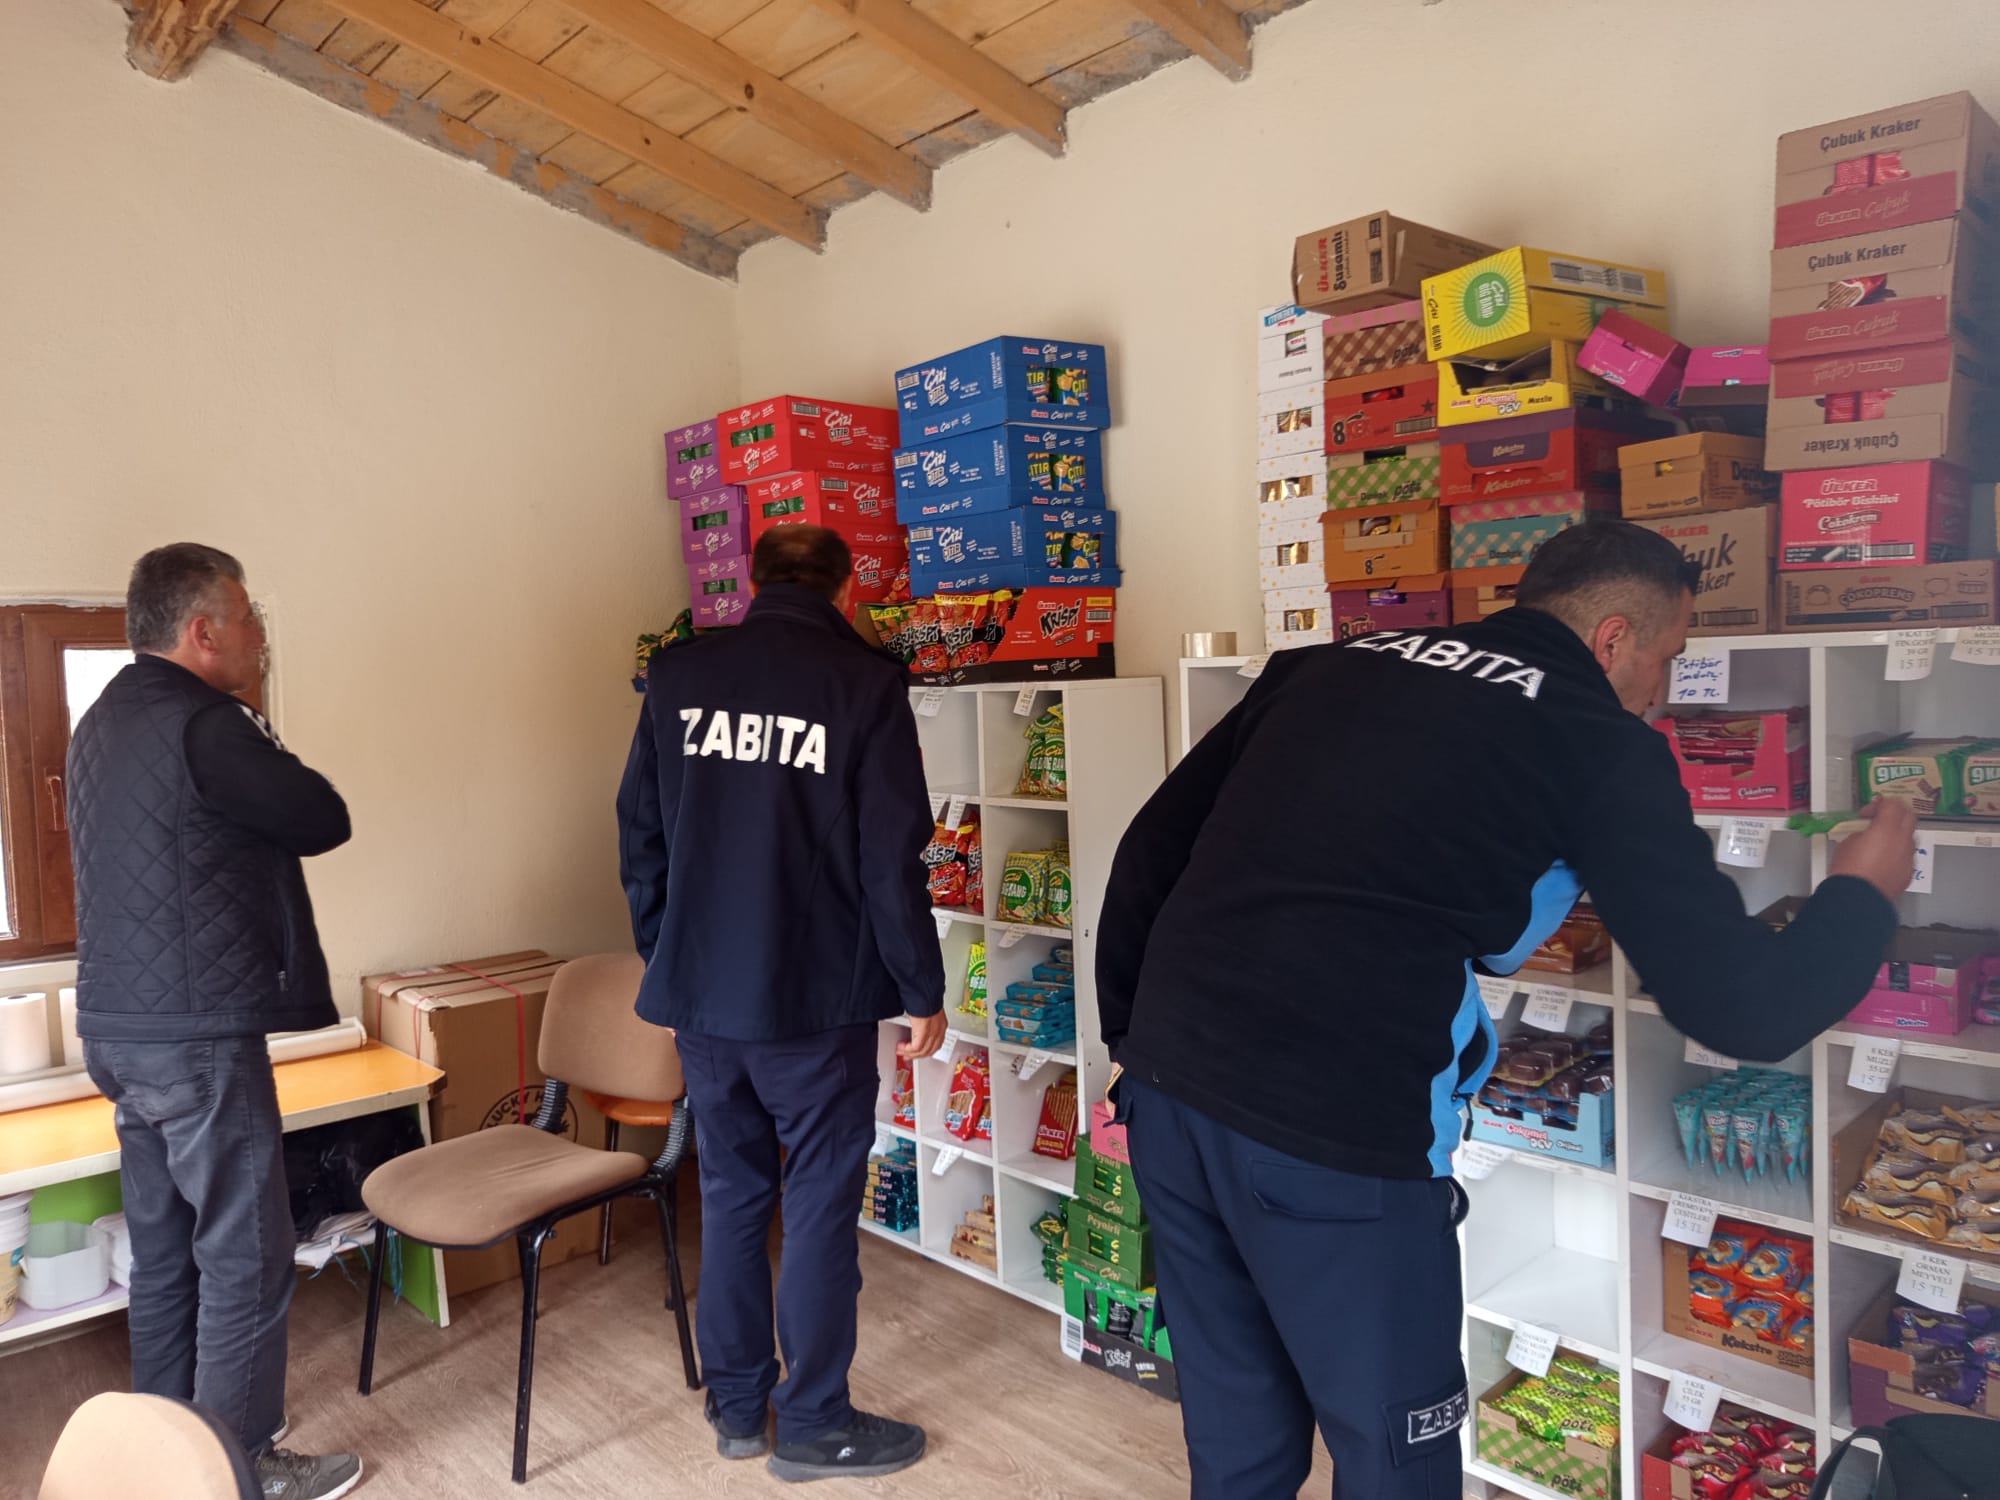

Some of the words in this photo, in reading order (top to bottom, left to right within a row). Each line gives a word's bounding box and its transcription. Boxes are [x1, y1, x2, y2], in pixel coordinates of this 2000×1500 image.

[1820, 129, 1866, 153] Çubuk
[1870, 118, 1921, 140] Kraker
[1808, 251, 1852, 272] Çubuk
[1857, 243, 1907, 262] Kraker
[923, 366, 948, 392] Çizi
[824, 410, 853, 428] Çizi
[1332, 420, 1346, 446] 8
[1854, 431, 1899, 450] Çubuk
[1803, 440, 1851, 453] Kraker
[922, 450, 947, 471] Çizi
[853, 483, 881, 501] Çizi
[1820, 477, 1878, 495] ÜLKER
[1803, 497, 1850, 509] Pötibör
[1817, 510, 1880, 534] Çokokrem
[938, 526, 963, 547] Çizi
[854, 554, 882, 572] Çizi
[1680, 533, 1737, 572] buk
[1695, 571, 1736, 595] aker
[1344, 631, 1546, 701] ZABITA
[679, 707, 827, 775] ZABITA
[1876, 766, 1889, 783] 9
[1971, 767, 1984, 783] 9
[1087, 1213, 1121, 1235] Peynirli
[1418, 1396, 1467, 1435] ZABIT
